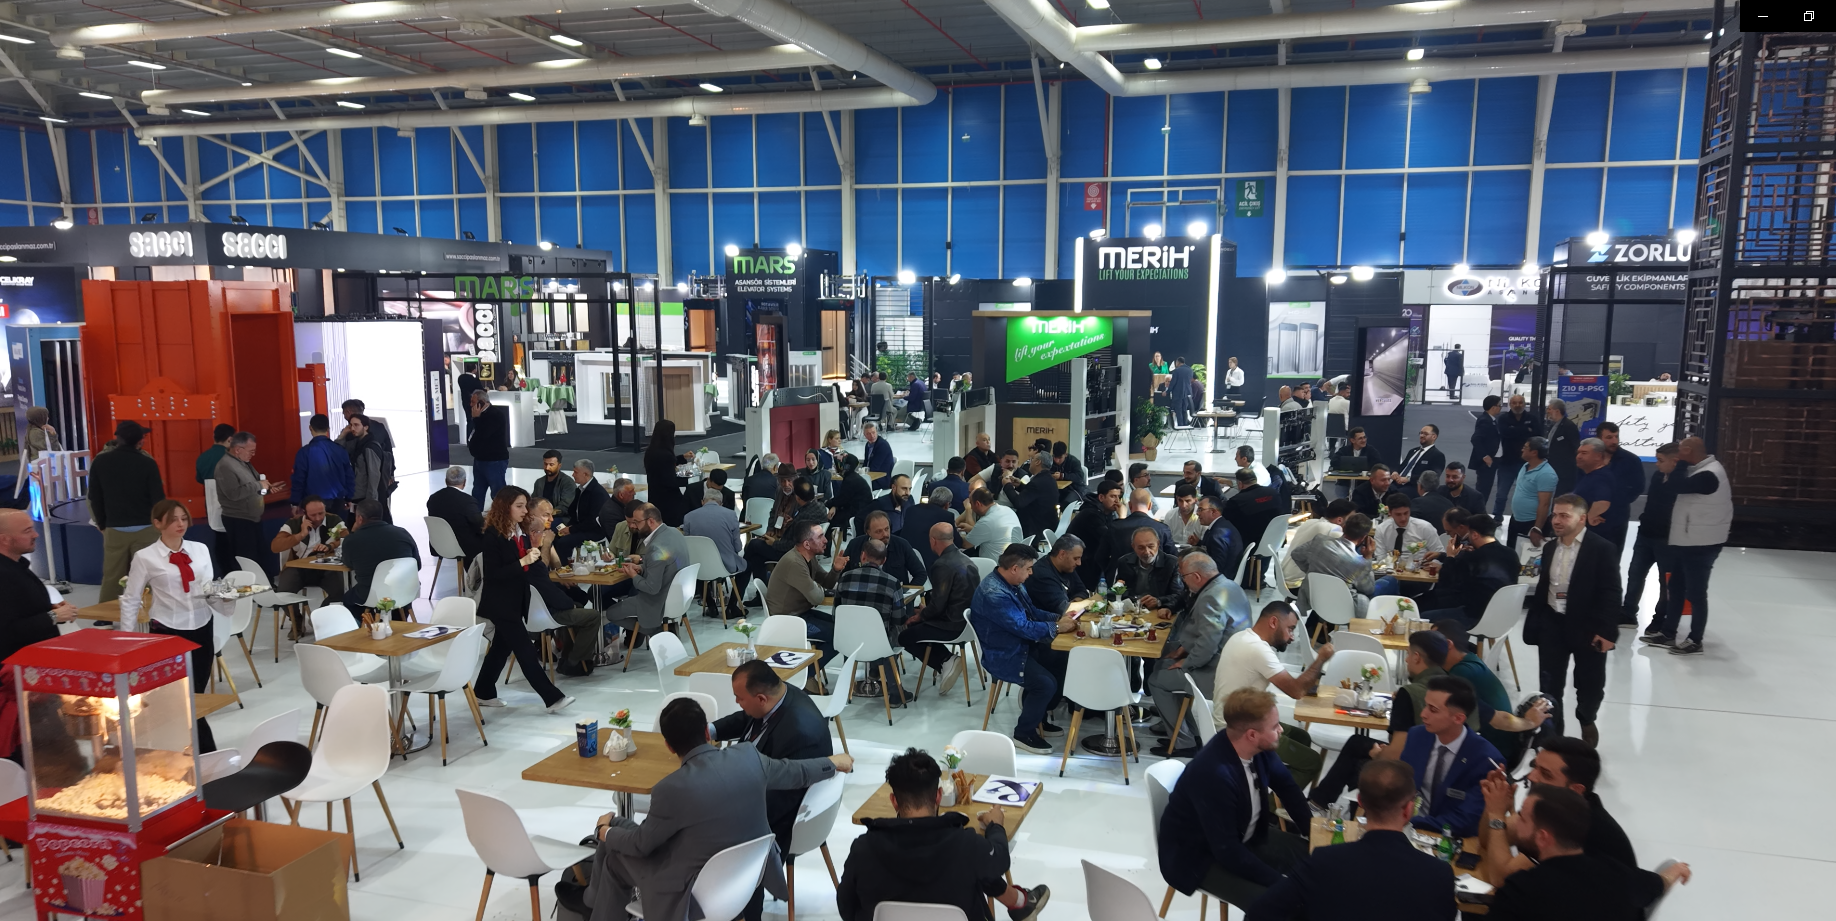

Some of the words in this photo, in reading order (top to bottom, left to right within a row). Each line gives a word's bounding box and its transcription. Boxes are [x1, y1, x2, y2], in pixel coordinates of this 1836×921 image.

[1613, 243, 1692, 263] ZORLU
[1099, 269, 1113, 280] LIFT
[1114, 269, 1134, 280] YOUR
[1136, 268, 1189, 279] EXPECTATIONS
[1624, 283, 1686, 291] COMPONENTS
